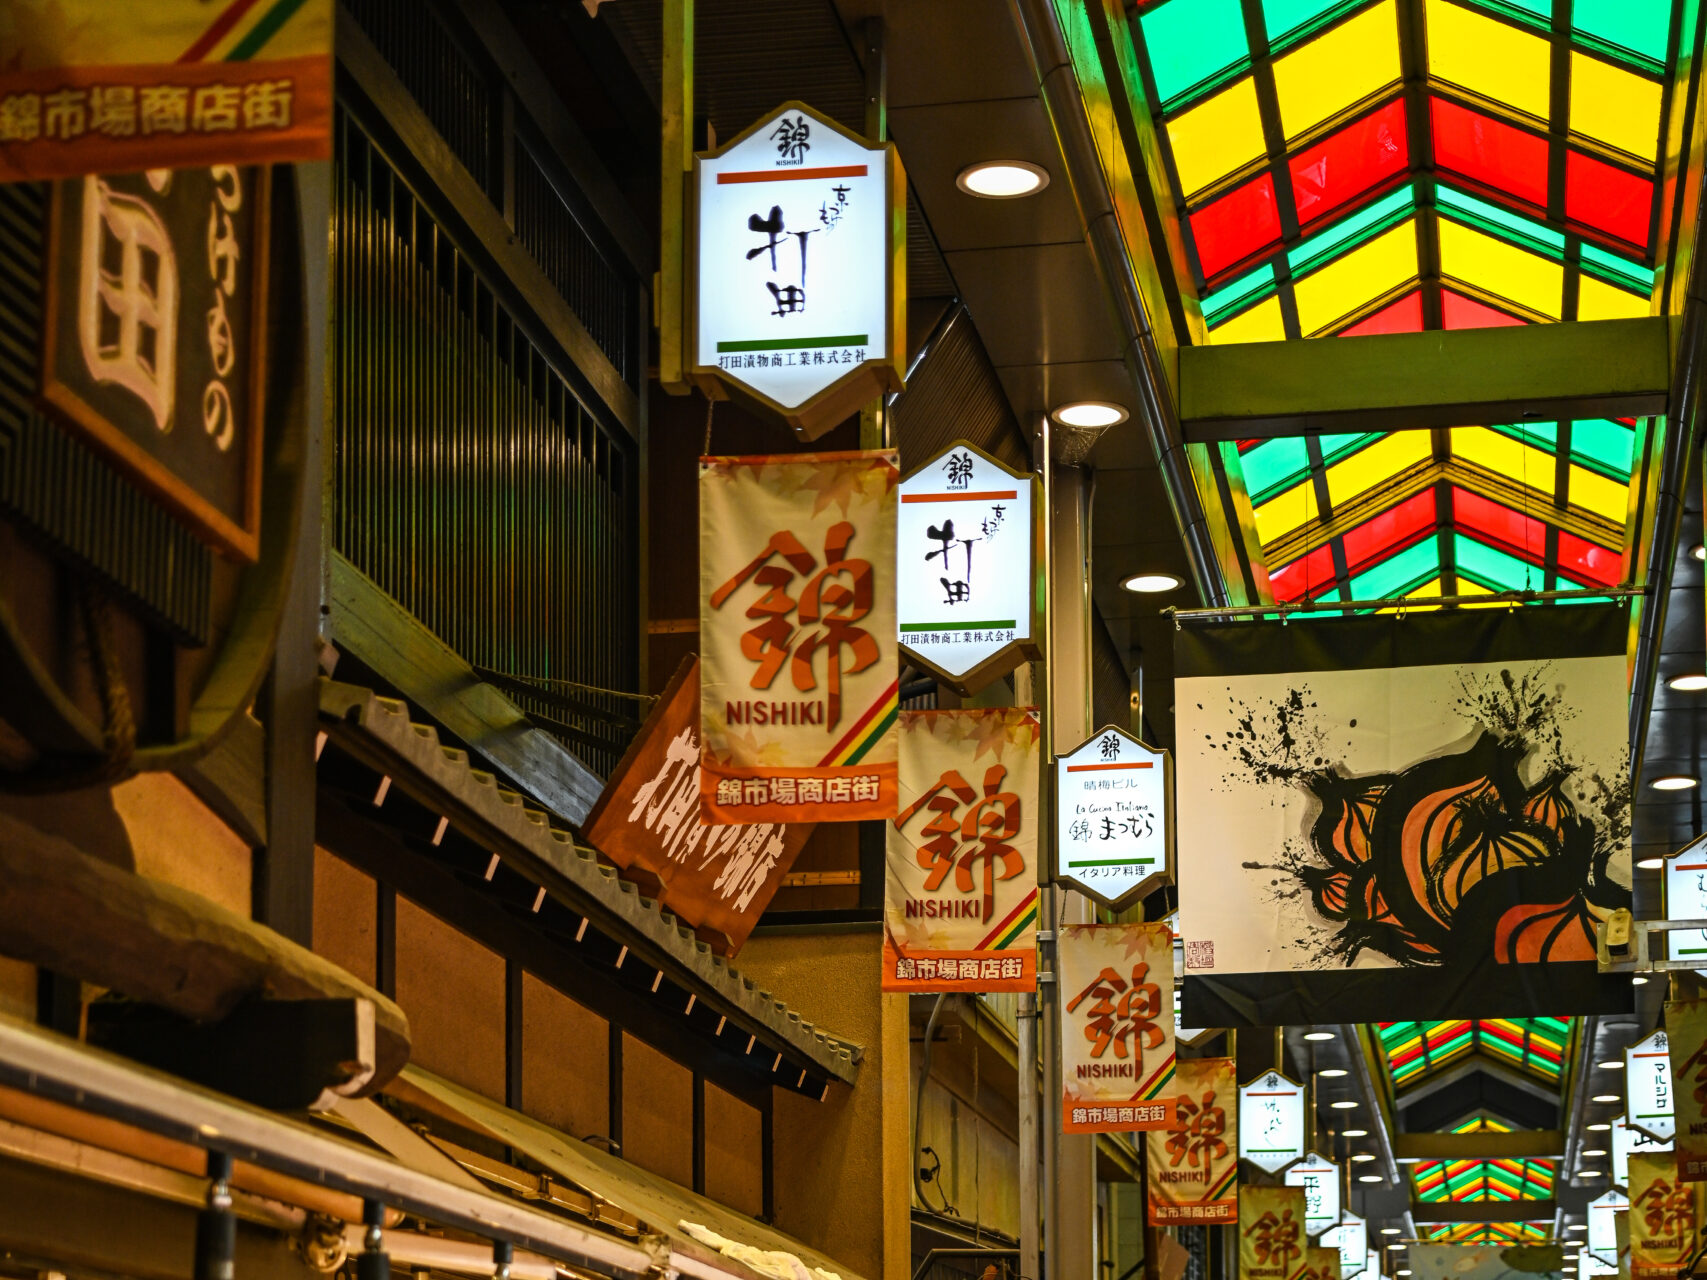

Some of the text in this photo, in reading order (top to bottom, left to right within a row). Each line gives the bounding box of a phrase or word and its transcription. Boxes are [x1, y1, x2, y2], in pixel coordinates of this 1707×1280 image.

[770, 116, 811, 164] 錦
[745, 204, 821, 318] 打田
[78, 165, 180, 433] 田
[718, 348, 867, 370] 打田漬物商工業株式会社
[942, 452, 974, 489] 錦
[924, 518, 984, 606] 打田
[709, 520, 881, 733] 錦
[726, 700, 824, 726] NISHIKI
[1097, 734, 1120, 761] 錦
[716, 774, 880, 806] 錦市場商店街
[1099, 812, 1155, 841] まつむら
[895, 763, 1026, 926] 錦
[1078, 865, 1146, 878] イタリア料理
[905, 899, 980, 920] NISHIKI
[895, 956, 1023, 981] 錦市場商店街
[1065, 963, 1166, 1083] 錦
[1076, 1064, 1133, 1079] NISHIKI
[1071, 1105, 1166, 1125] 錦市場商店街
[1166, 1090, 1229, 1187] 錦
[1159, 1171, 1203, 1183] NISHIKI
[1632, 1178, 1696, 1250] 錦
[1243, 1208, 1301, 1280] 錦
